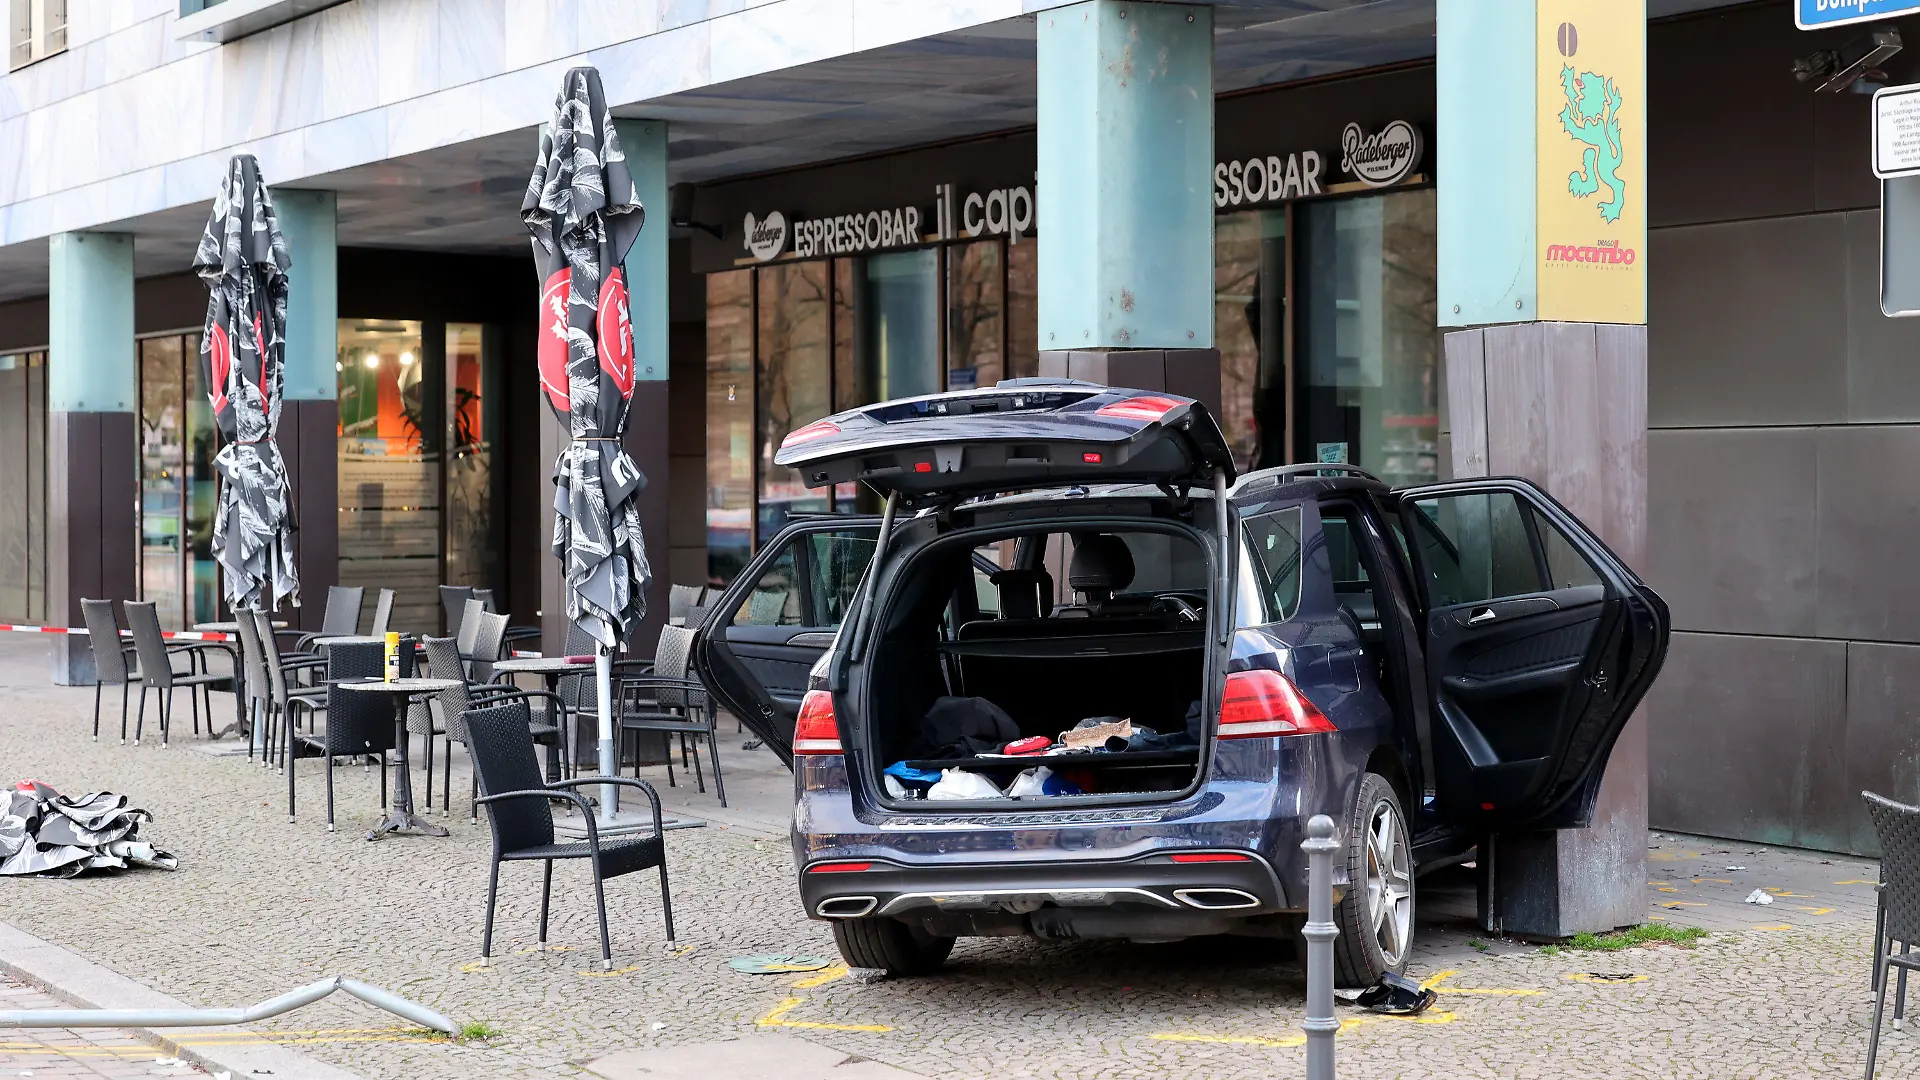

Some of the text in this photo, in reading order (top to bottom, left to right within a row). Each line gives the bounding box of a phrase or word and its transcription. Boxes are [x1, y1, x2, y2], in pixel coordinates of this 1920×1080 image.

[1343, 125, 1411, 168] Radeberger
[794, 205, 919, 257] ESPRESSOBAR
[936, 183, 951, 240] il
[1546, 240, 1635, 265] mocambo
